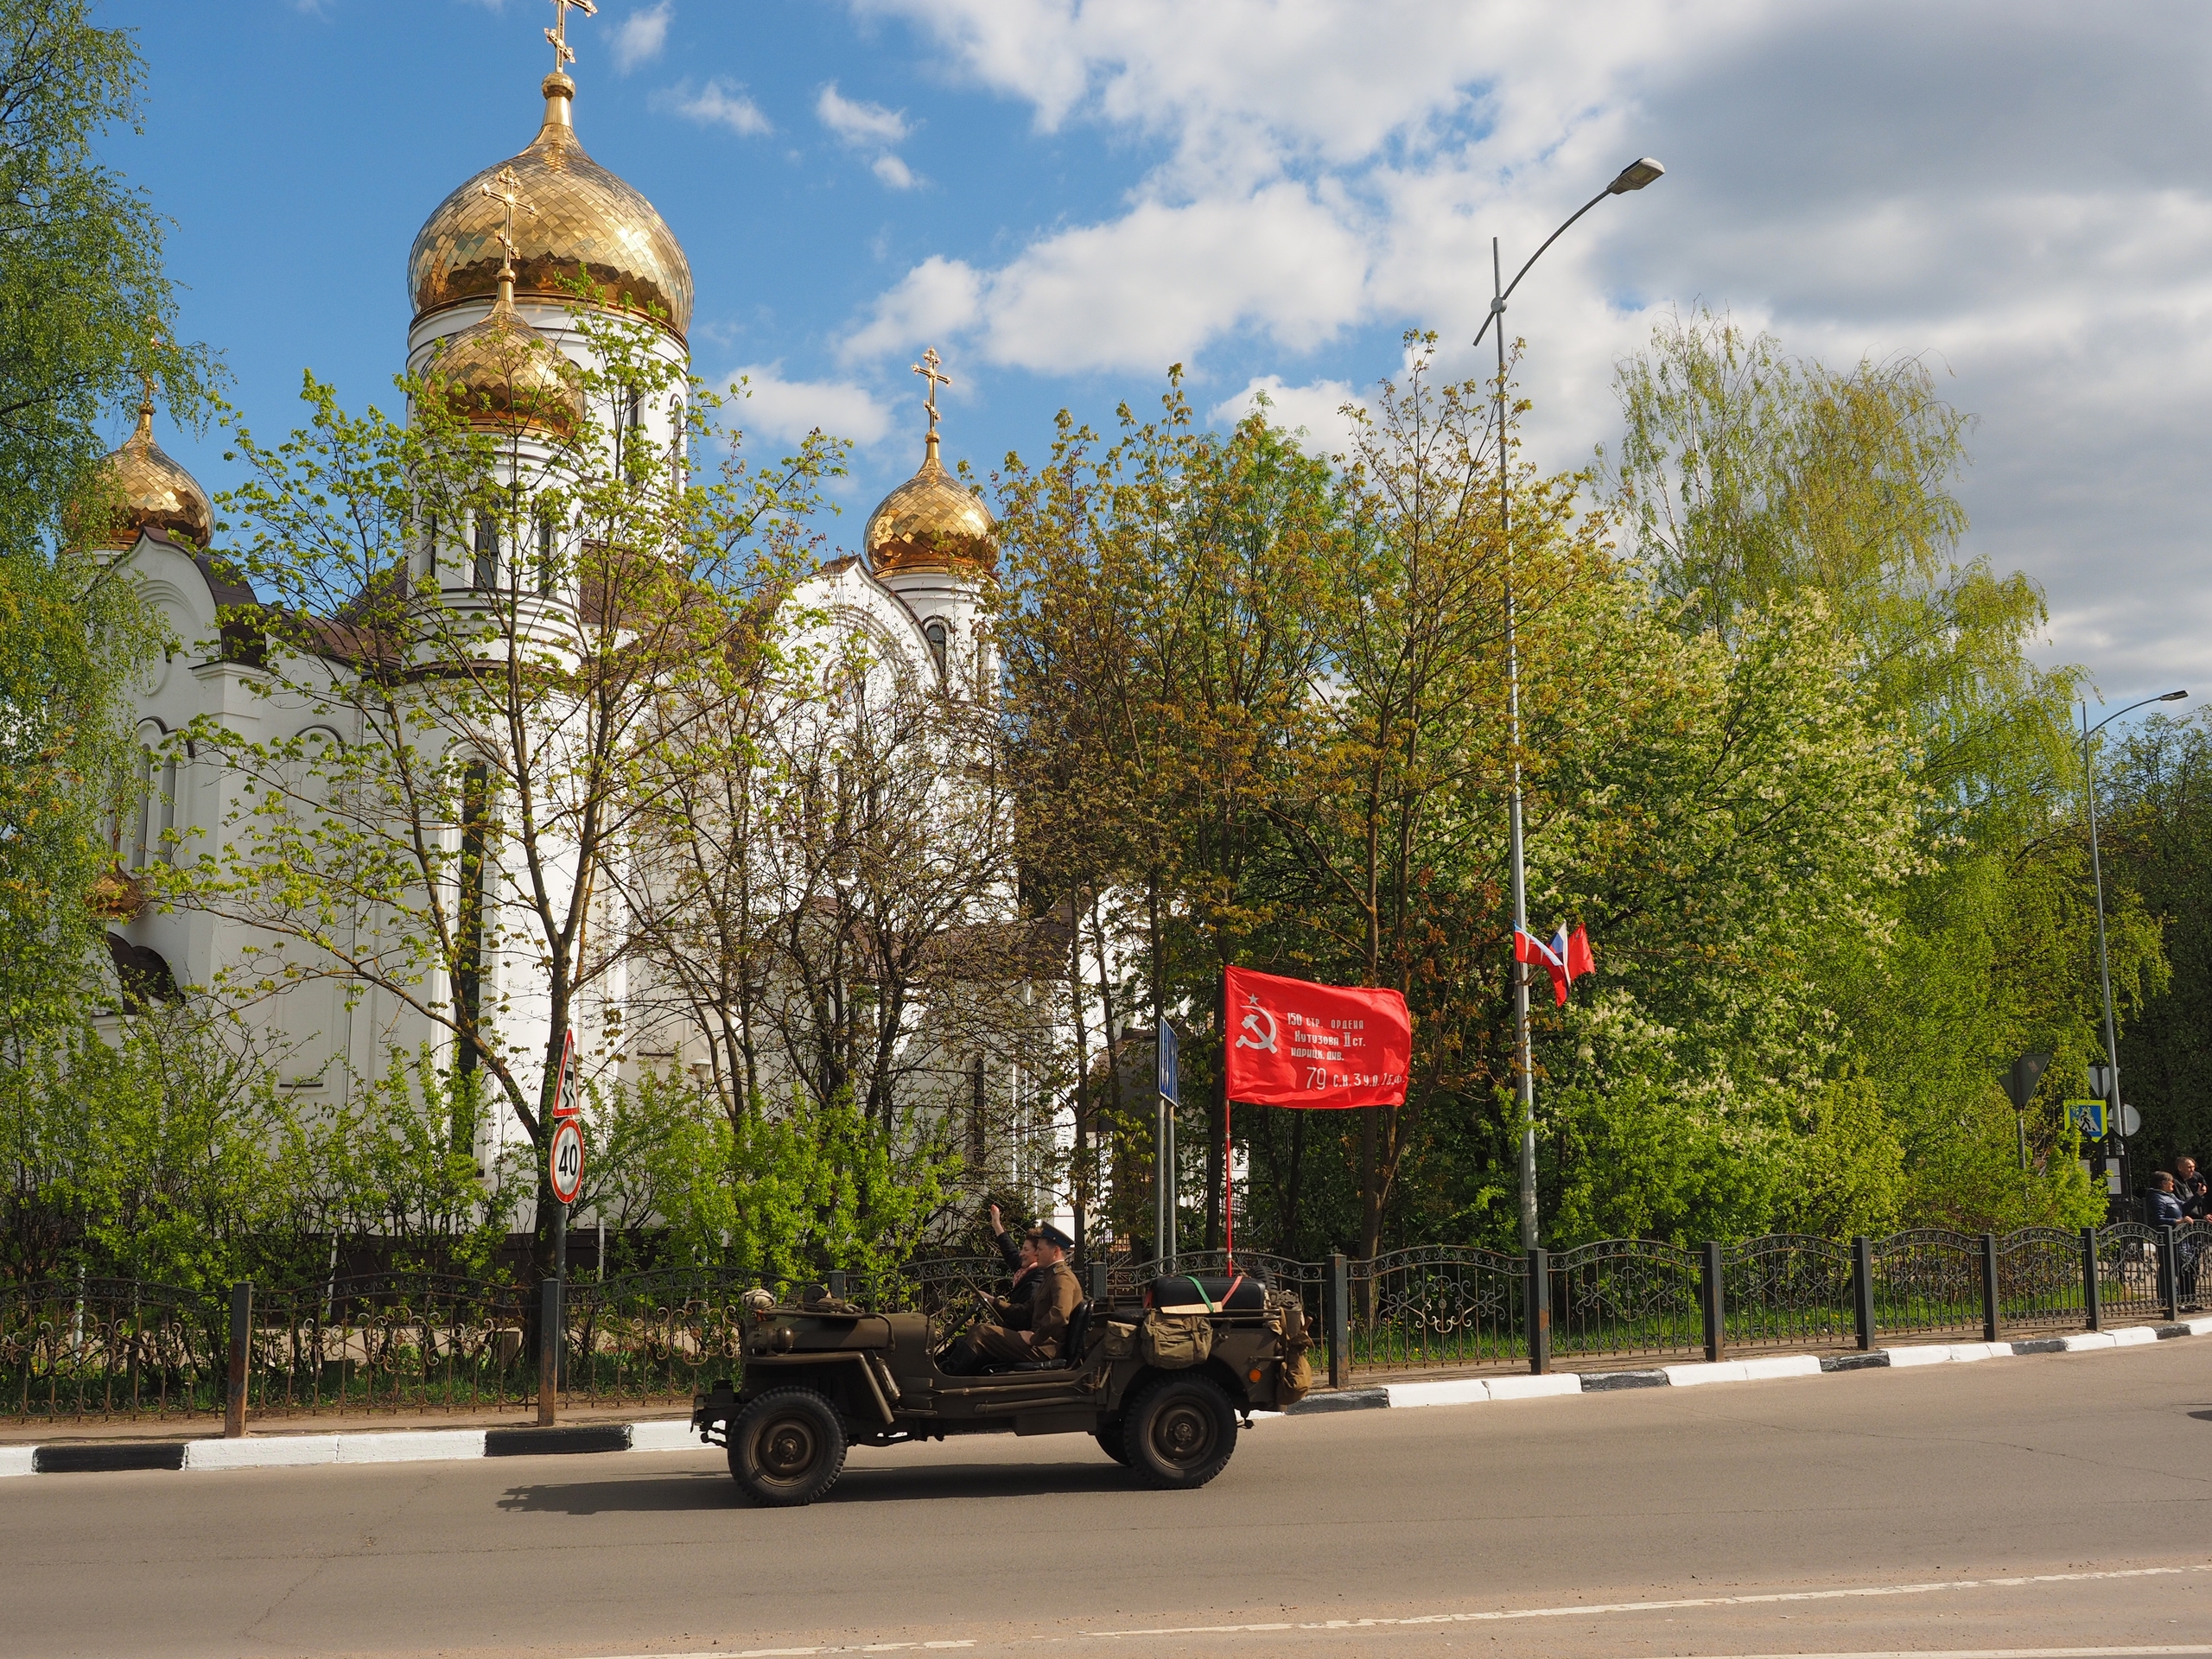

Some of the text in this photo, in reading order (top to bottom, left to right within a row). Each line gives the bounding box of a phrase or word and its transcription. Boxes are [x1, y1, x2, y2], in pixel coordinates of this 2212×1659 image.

[1287, 1012, 1364, 1030] 150 СТР. ОРДЕНА
[1352, 1037, 1366, 1046] СТ.
[1291, 1047, 1344, 1061] ИДРИЦК. ДИВ.
[1306, 1066, 1326, 1090] 79
[558, 1143, 578, 1177] 40
